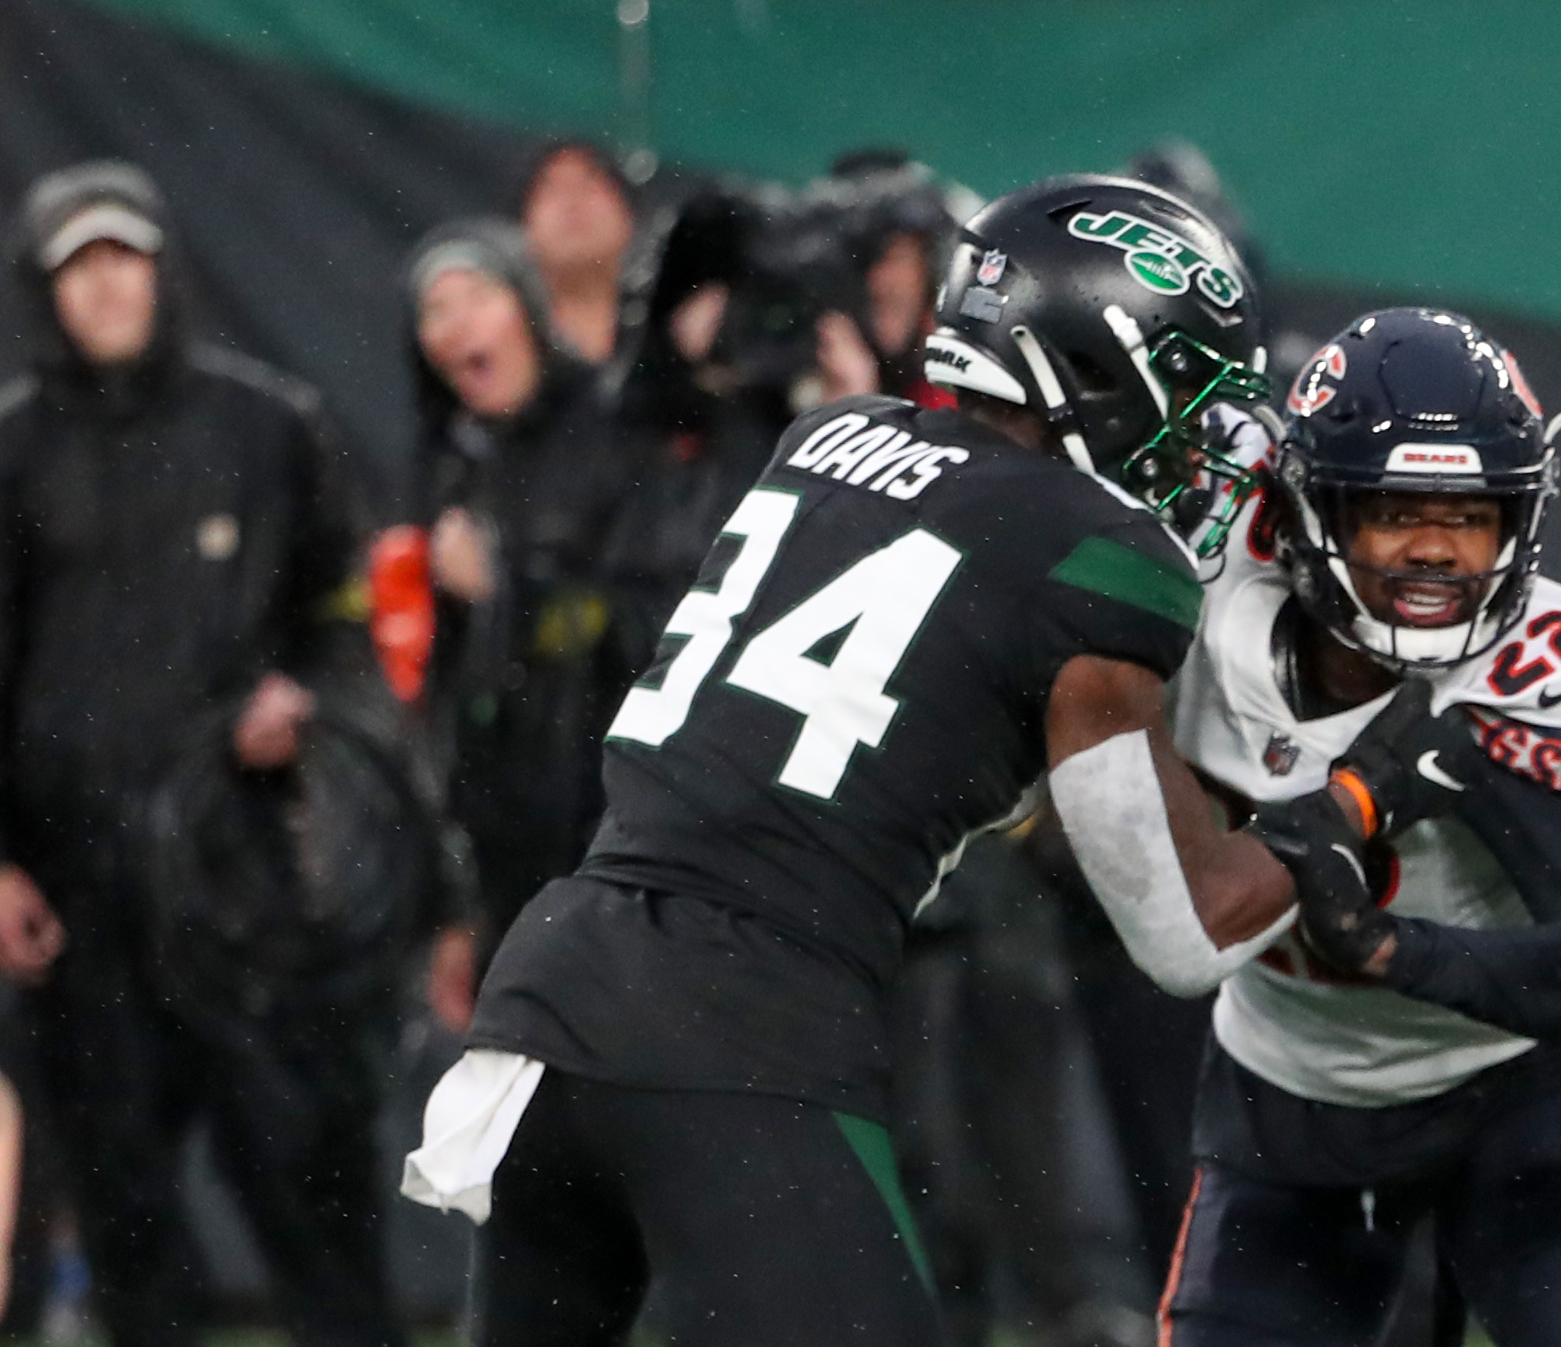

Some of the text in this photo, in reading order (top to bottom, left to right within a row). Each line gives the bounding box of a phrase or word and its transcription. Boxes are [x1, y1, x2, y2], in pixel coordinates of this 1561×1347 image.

[1068, 210, 1244, 308] JETS
[787, 412, 971, 501] DAVIS
[1403, 453, 1467, 465] BEARS
[606, 488, 964, 801] 34
